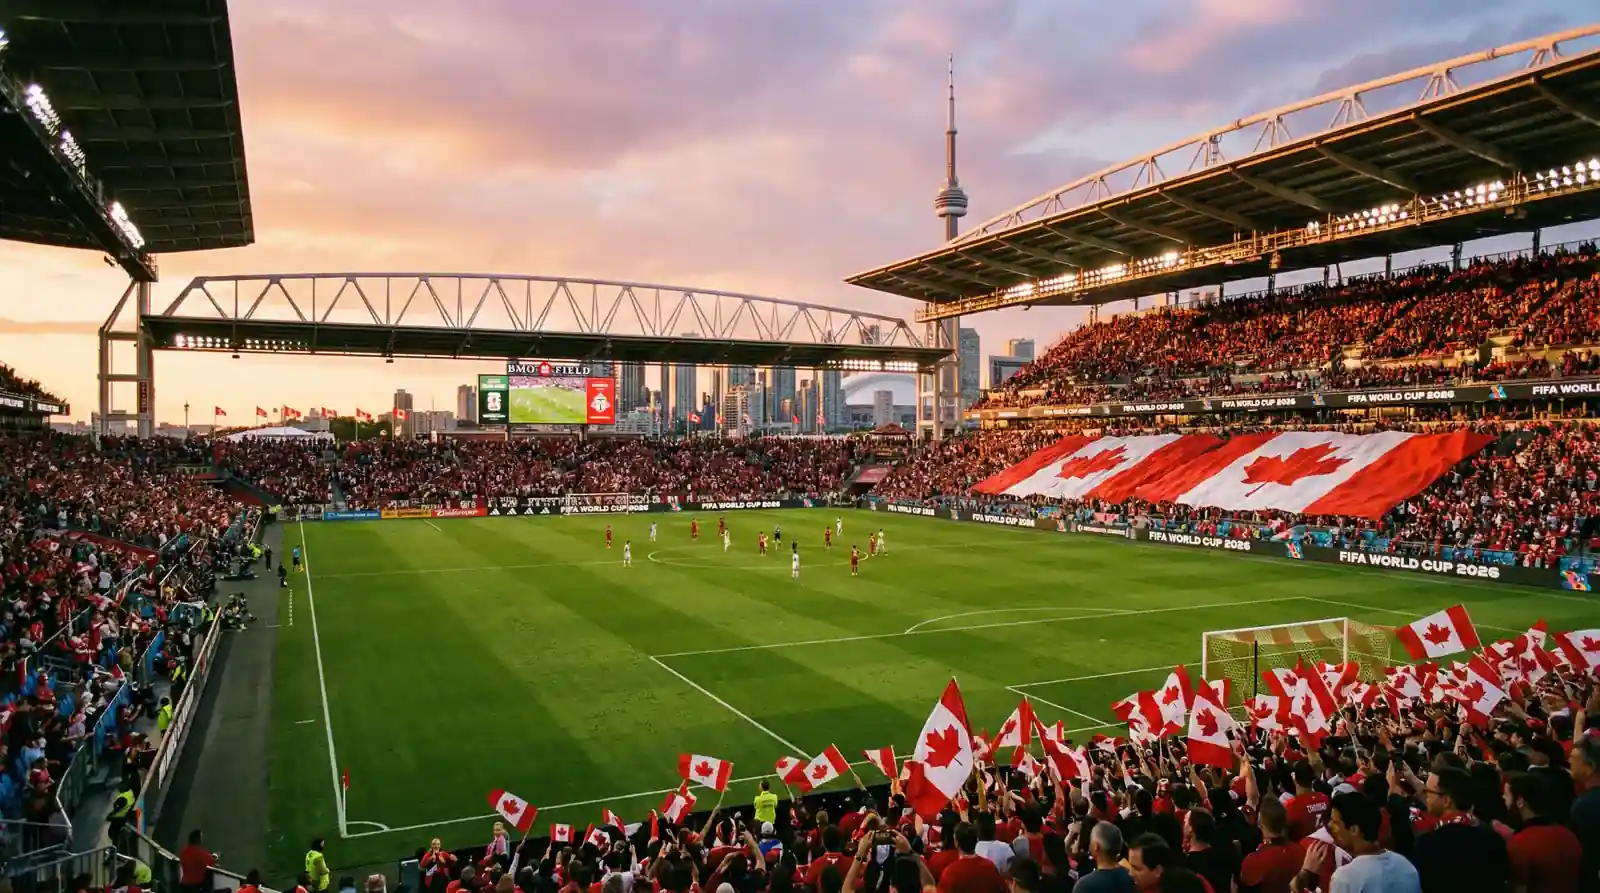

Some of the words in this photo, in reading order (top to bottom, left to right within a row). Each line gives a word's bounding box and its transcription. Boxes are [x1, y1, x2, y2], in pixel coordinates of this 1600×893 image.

[507, 364, 535, 374] BMO
[555, 366, 591, 375] FIELD
[1532, 384, 1559, 396] FIFA
[1236, 399, 1261, 407] WORLD
[1261, 398, 1276, 406] CUP
[1347, 394, 1367, 403] FIFA
[1368, 392, 1403, 402] WORLD
[1404, 391, 1425, 400] CUP
[580, 504, 610, 512] WORLD
[701, 502, 719, 510] FIFA
[745, 501, 762, 509] CUP
[1149, 531, 1167, 542] FIFA
[1168, 533, 1201, 545] WORLD
[1202, 537, 1222, 548] CUP
[1224, 539, 1251, 551] 2026
[1339, 550, 1367, 564] FIFA
[1368, 553, 1420, 570] WORLD
[1421, 559, 1453, 573] CUP
[1456, 563, 1500, 579] 2026
